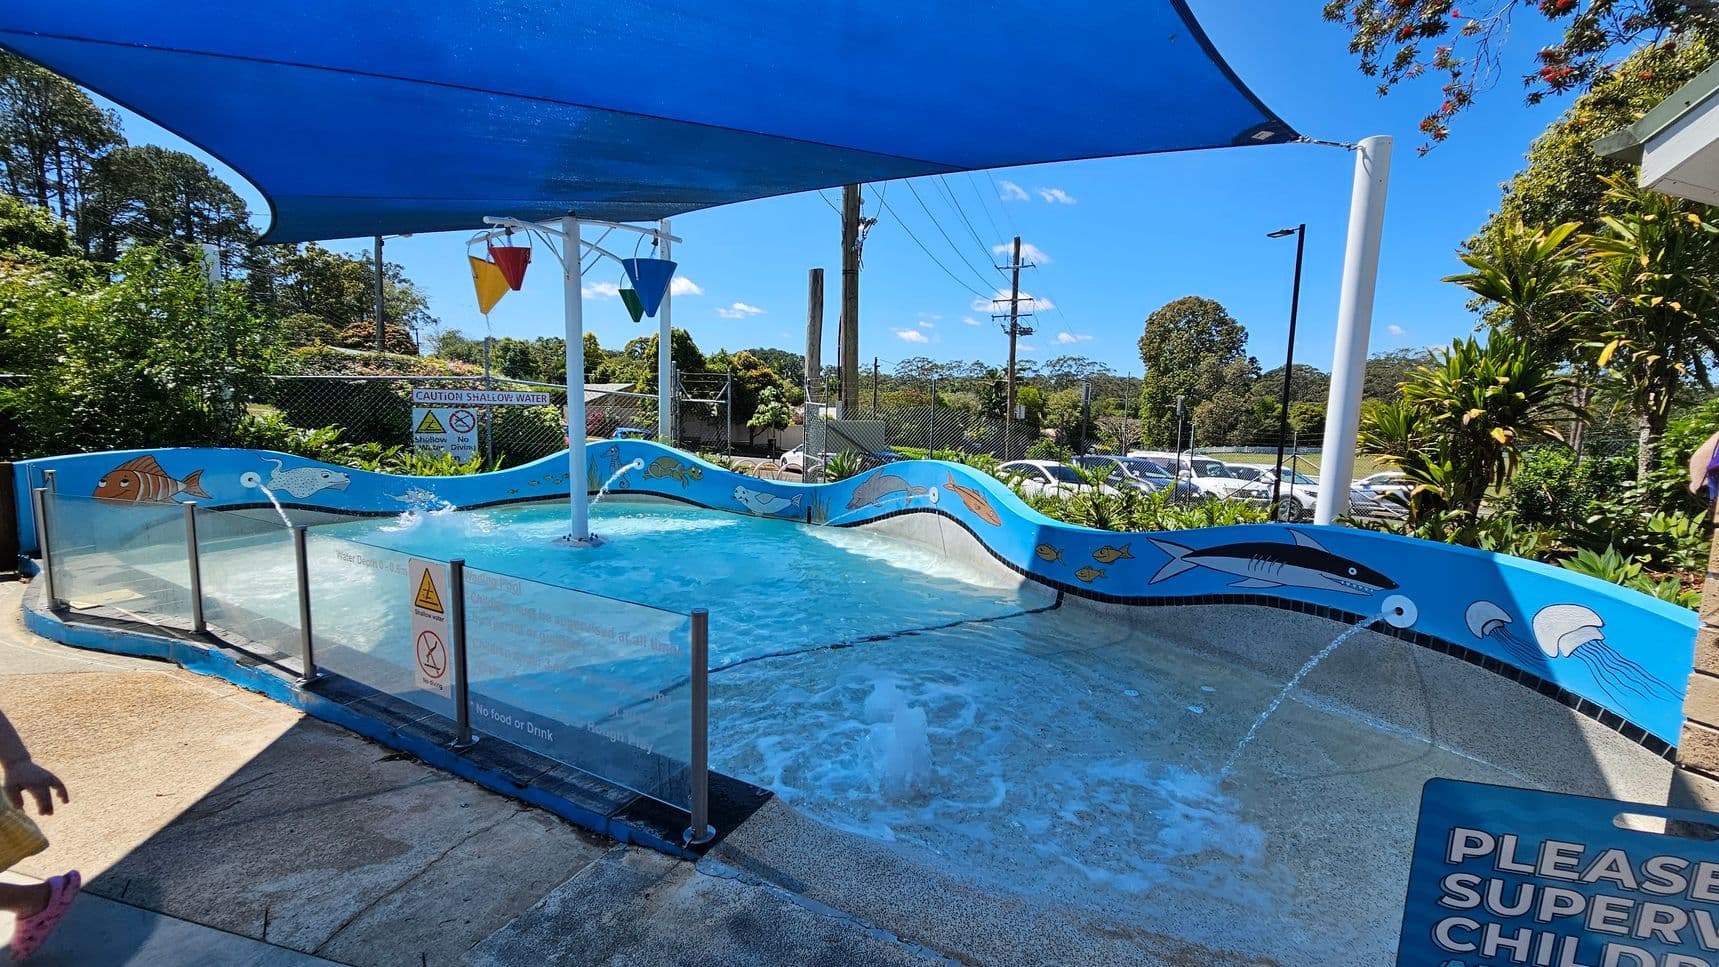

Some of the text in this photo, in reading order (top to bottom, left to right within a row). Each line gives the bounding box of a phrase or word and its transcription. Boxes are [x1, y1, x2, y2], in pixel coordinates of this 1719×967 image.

[415, 391, 548, 404] CAUTION SHALLOW WATER
[336, 549, 356, 563] Water
[357, 555, 378, 569] Depth
[476, 703, 489, 717] No
[491, 708, 513, 725] food
[514, 719, 525, 730] or
[527, 722, 554, 742] Drink
[587, 720, 625, 742] Rough
[1447, 827, 1719, 903] PLEASE
